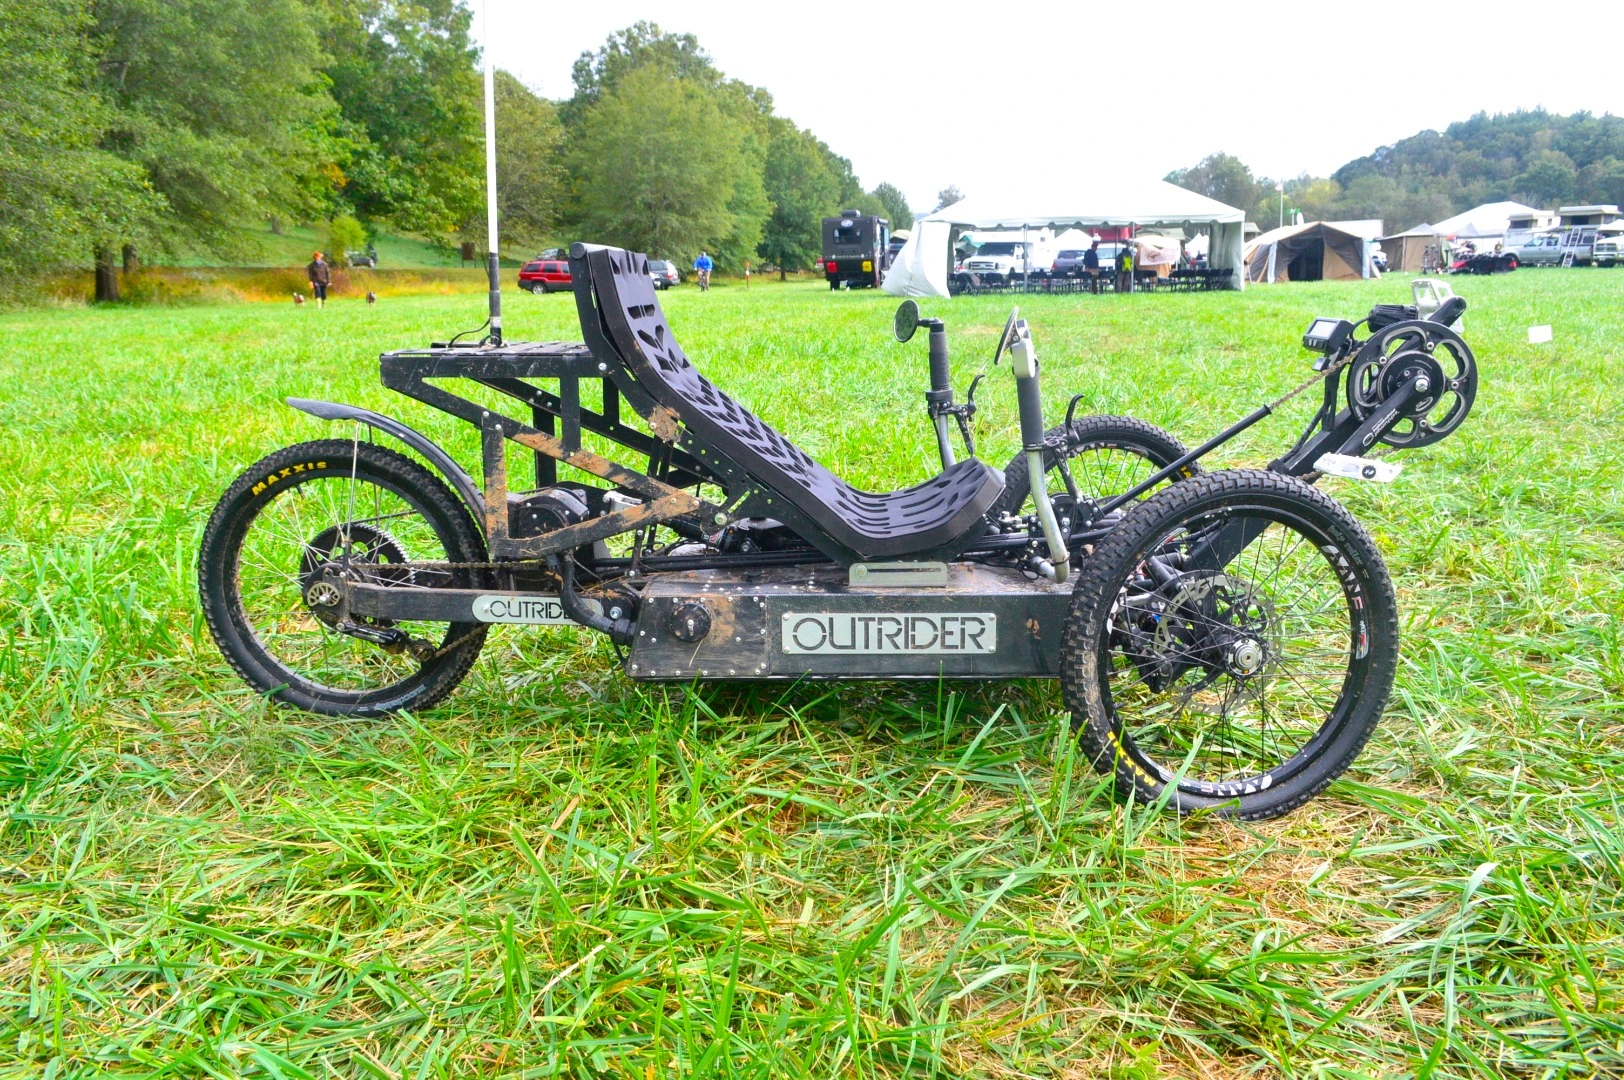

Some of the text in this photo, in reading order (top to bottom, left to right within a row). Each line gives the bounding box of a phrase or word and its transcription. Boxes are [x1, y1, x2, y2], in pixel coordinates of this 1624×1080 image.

[252, 461, 327, 496] MAXXIS
[489, 600, 569, 620] OUTRID
[792, 616, 987, 651] OUTRIDER
